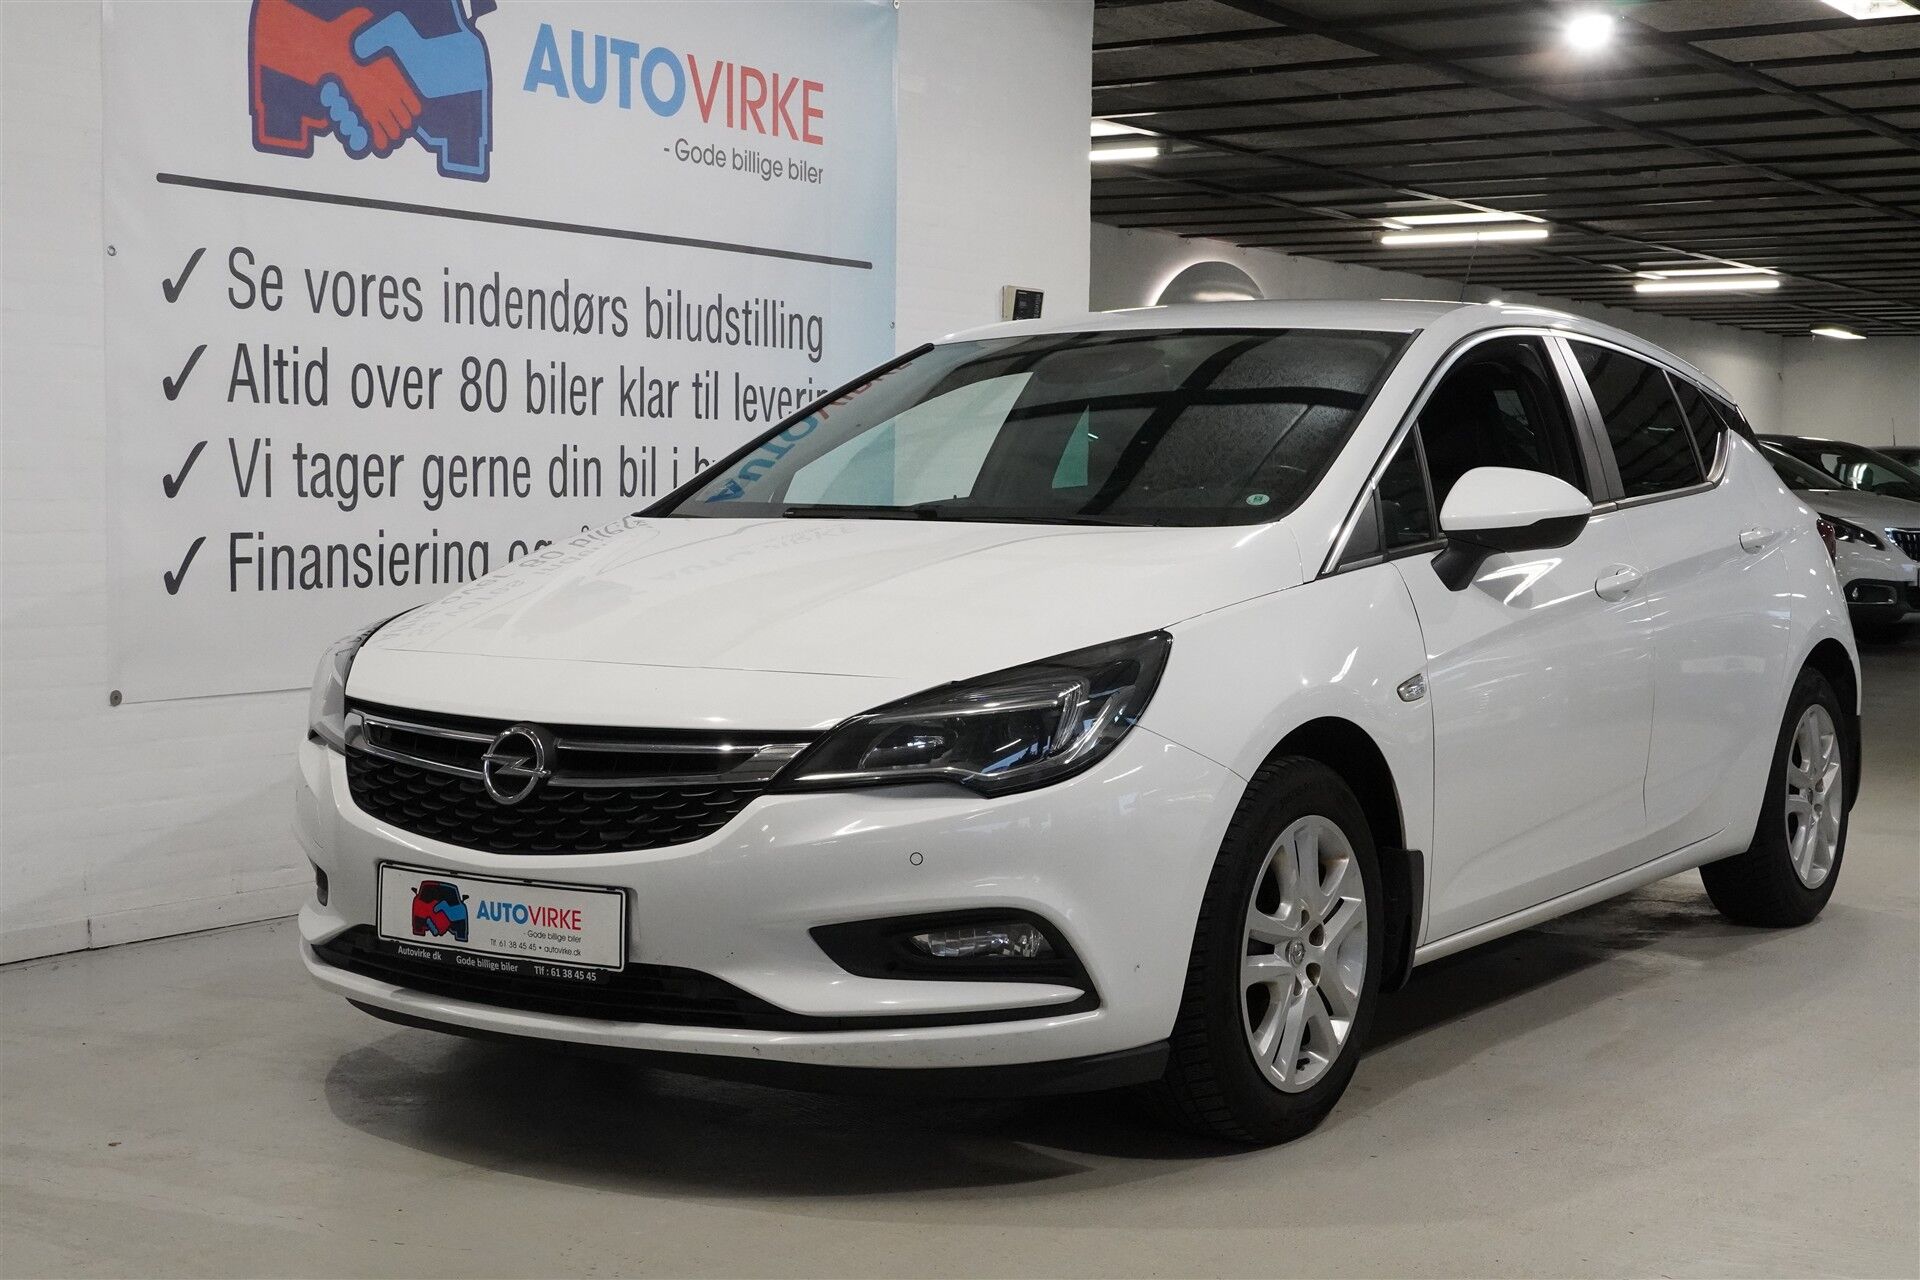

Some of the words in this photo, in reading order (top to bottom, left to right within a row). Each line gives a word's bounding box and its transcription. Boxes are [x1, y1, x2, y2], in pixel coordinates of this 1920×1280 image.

[523, 22, 824, 146] AUTOVIRKE
[674, 137, 727, 169] Gode
[732, 147, 783, 182] billige
[788, 158, 824, 185] biler
[228, 246, 283, 312] Se
[304, 268, 424, 323] vores
[443, 266, 629, 338] indendørs
[645, 286, 824, 362] biludstilling
[227, 342, 328, 407] Altid
[351, 362, 443, 410] over
[460, 355, 508, 414] 80
[526, 358, 604, 417] biler
[619, 364, 680, 419] klar
[691, 370, 719, 420] til
[228, 437, 272, 498] Vi
[292, 442, 405, 512] tager
[422, 454, 531, 512] gerne
[548, 443, 602, 499] din
[619, 444, 657, 498] bil
[229, 528, 489, 593] Finansiering
[476, 900, 582, 931] AUTOVIRKE
[527, 930, 547, 939] Gode
[547, 932, 567, 943] billige
[567, 935, 582, 944] biler
[397, 945, 431, 959] Autovirke
[456, 955, 476, 967] Gode
[477, 958, 500, 971] billige
[500, 962, 518, 972] biler
[534, 965, 544, 976] Tlf
[550, 967, 560, 977] 61
[562, 968, 573, 979] 38
[574, 970, 585, 980] 45
[586, 971, 597, 981] 45
[498, 940, 507, 948] 61
[509, 941, 517, 949] 38
[518, 942, 527, 950] 45
[528, 943, 537, 951] 45
[544, 945, 582, 957] autovirke.dk
